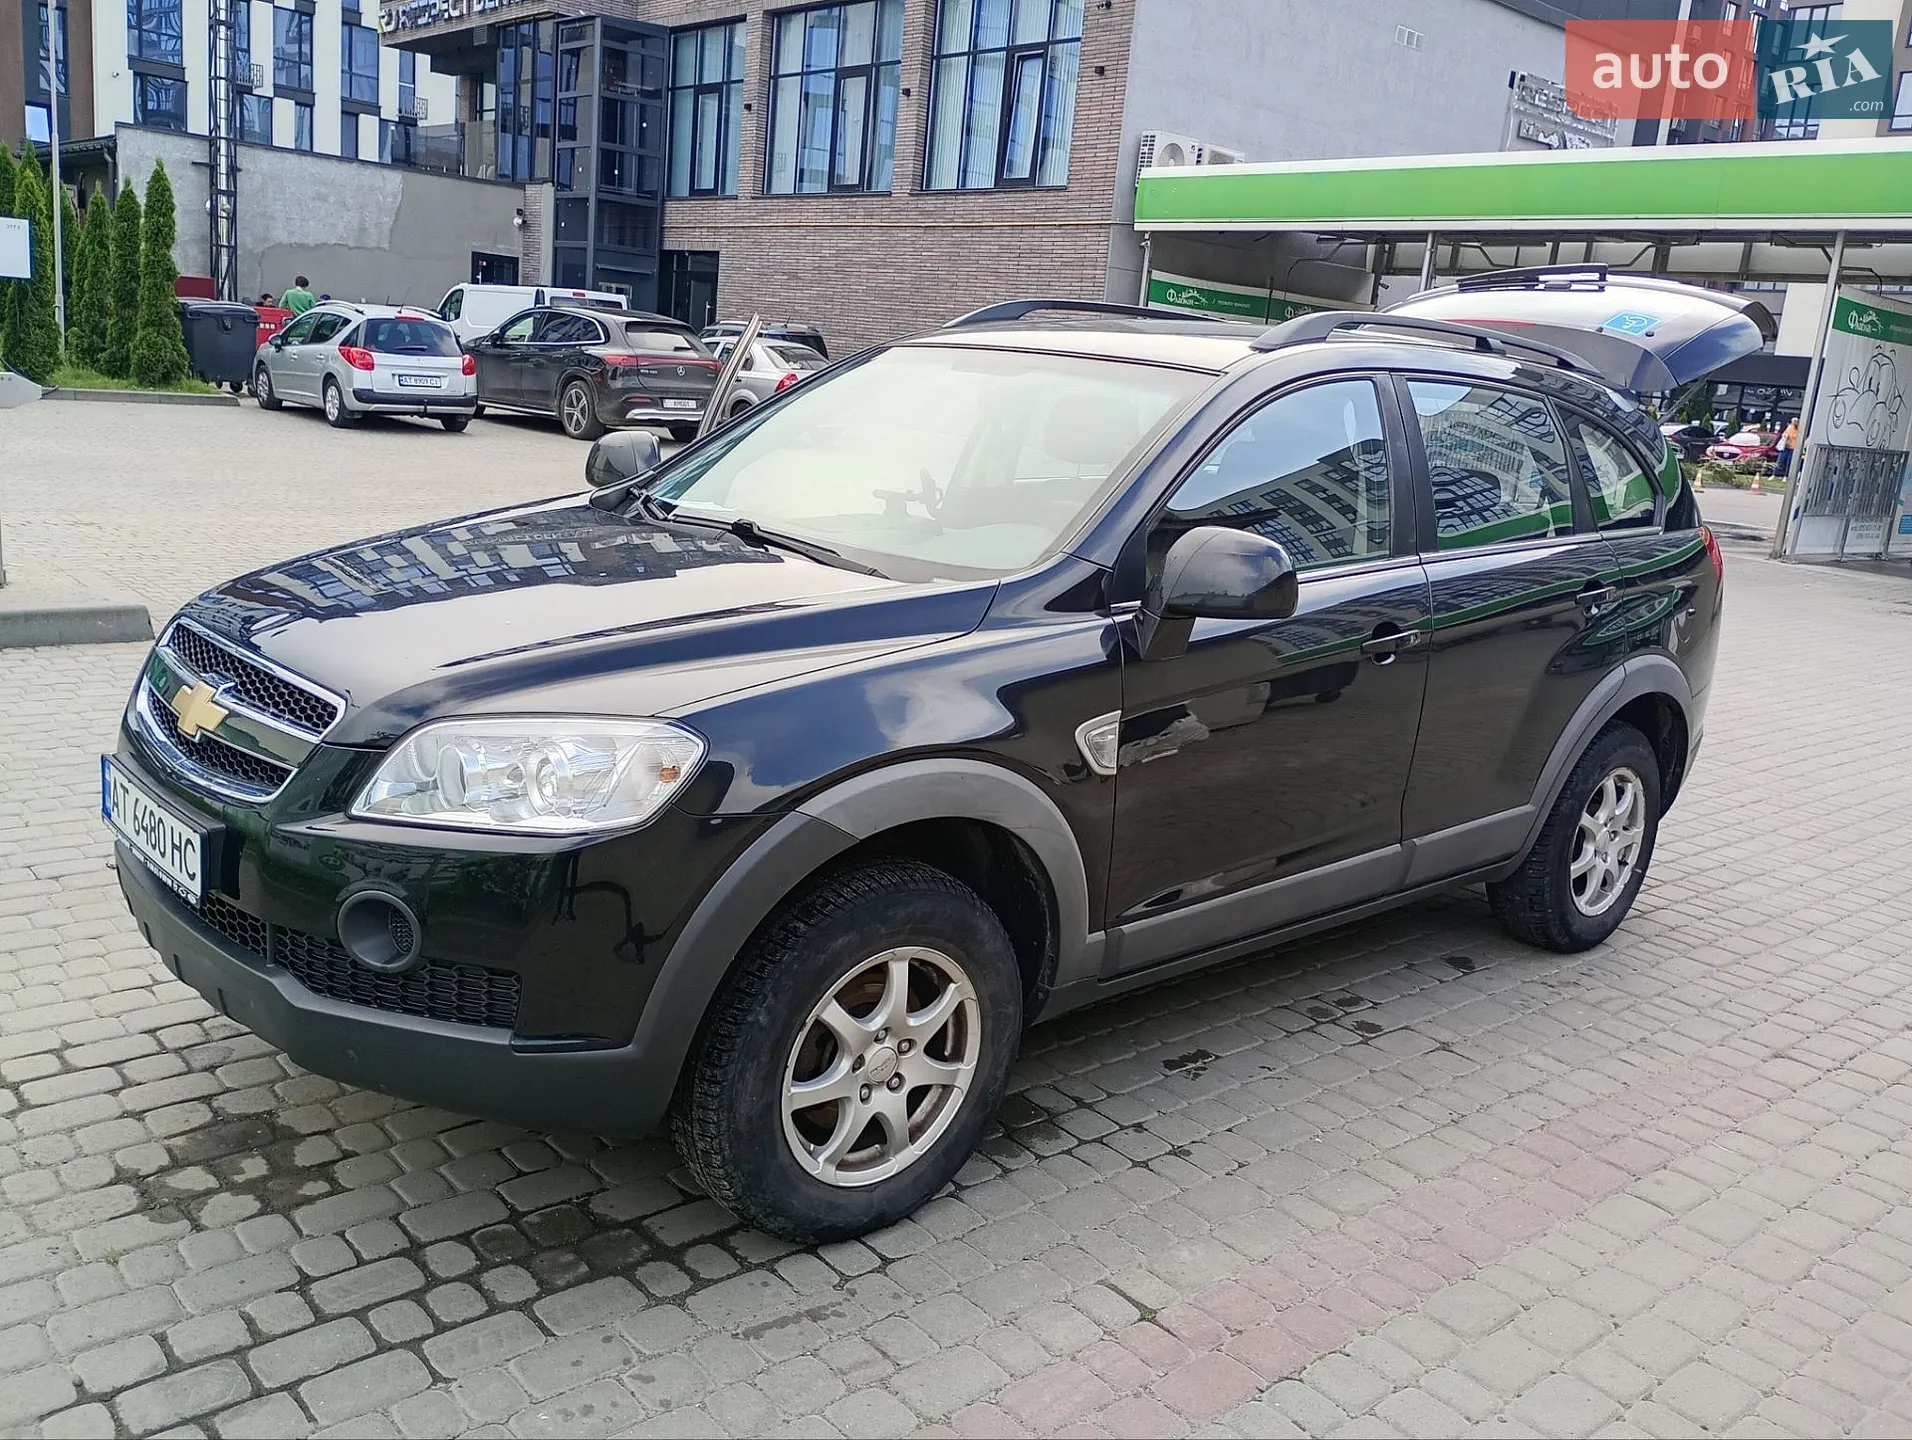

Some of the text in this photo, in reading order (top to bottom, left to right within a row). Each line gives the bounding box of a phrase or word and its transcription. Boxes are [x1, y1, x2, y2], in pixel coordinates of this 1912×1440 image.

[112, 777, 130, 825] AT
[133, 797, 167, 859] 6480
[170, 825, 197, 882] HC
